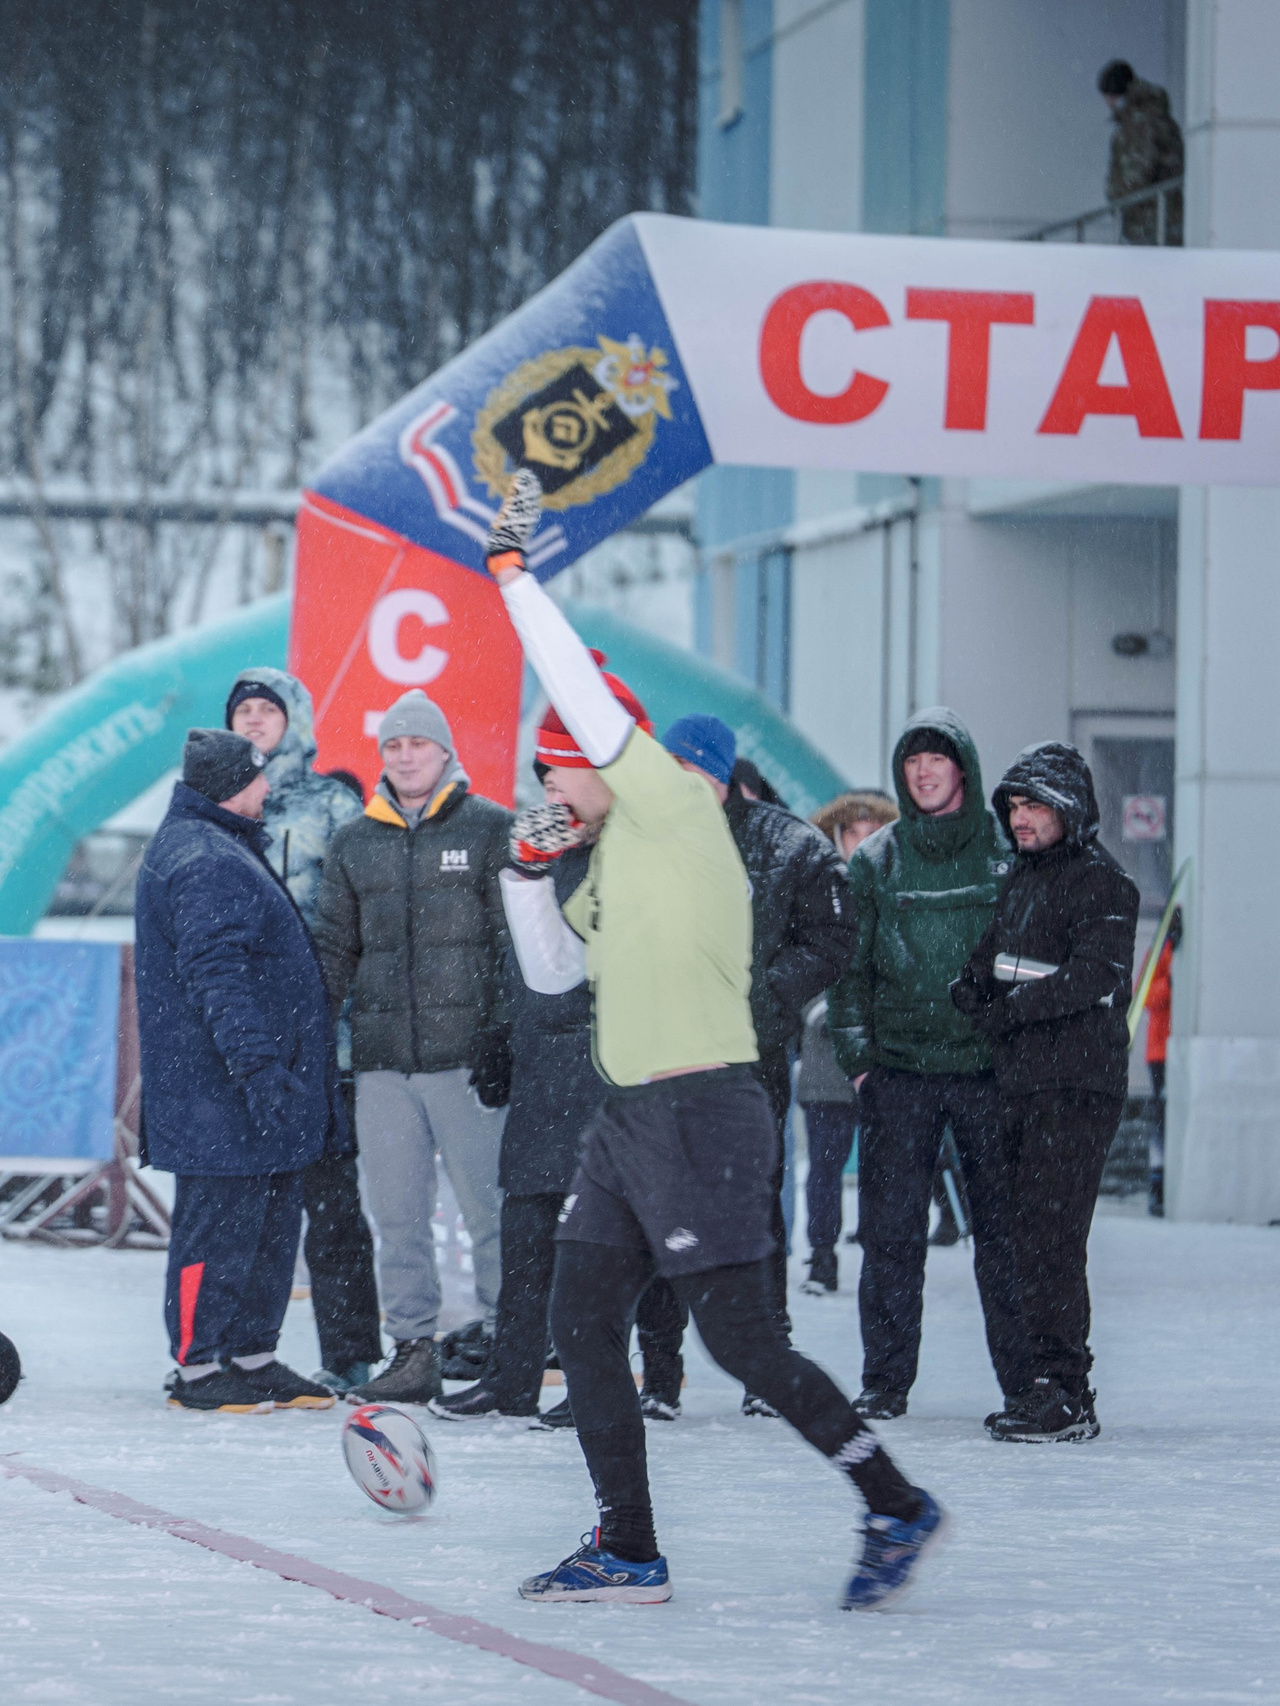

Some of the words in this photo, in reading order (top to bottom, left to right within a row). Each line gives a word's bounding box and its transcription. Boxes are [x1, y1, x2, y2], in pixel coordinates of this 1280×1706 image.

[757, 279, 1280, 441] СТАР
[365, 588, 451, 737] С
[365, 1449, 392, 1488] RUGBY.RU
